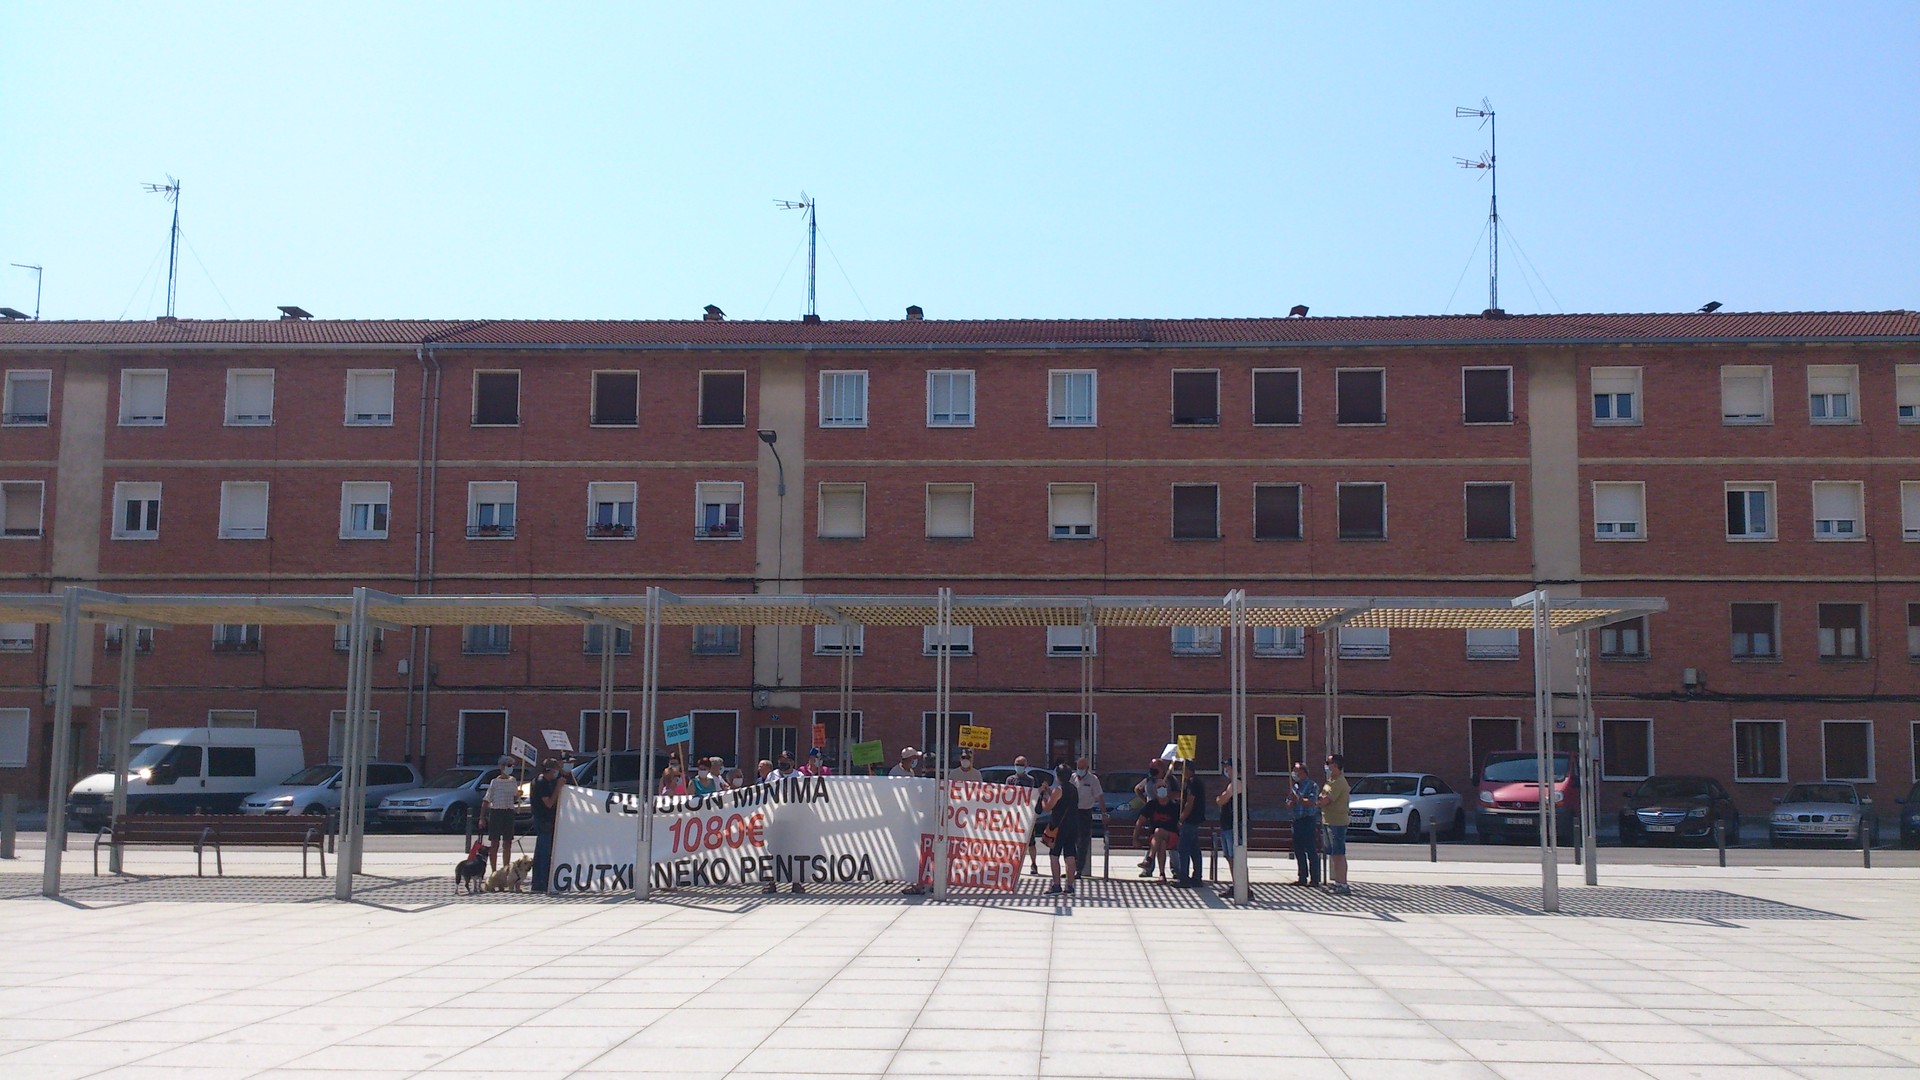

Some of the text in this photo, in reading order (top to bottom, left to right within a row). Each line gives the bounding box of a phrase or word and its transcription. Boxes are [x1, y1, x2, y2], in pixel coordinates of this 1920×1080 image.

[605, 791, 724, 814] PESION
[939, 780, 1033, 807] EVISION
[669, 813, 765, 854] 1080€
[974, 808, 1025, 834] REAL
[553, 854, 875, 892] GUTXINEKO PENTSIOA
